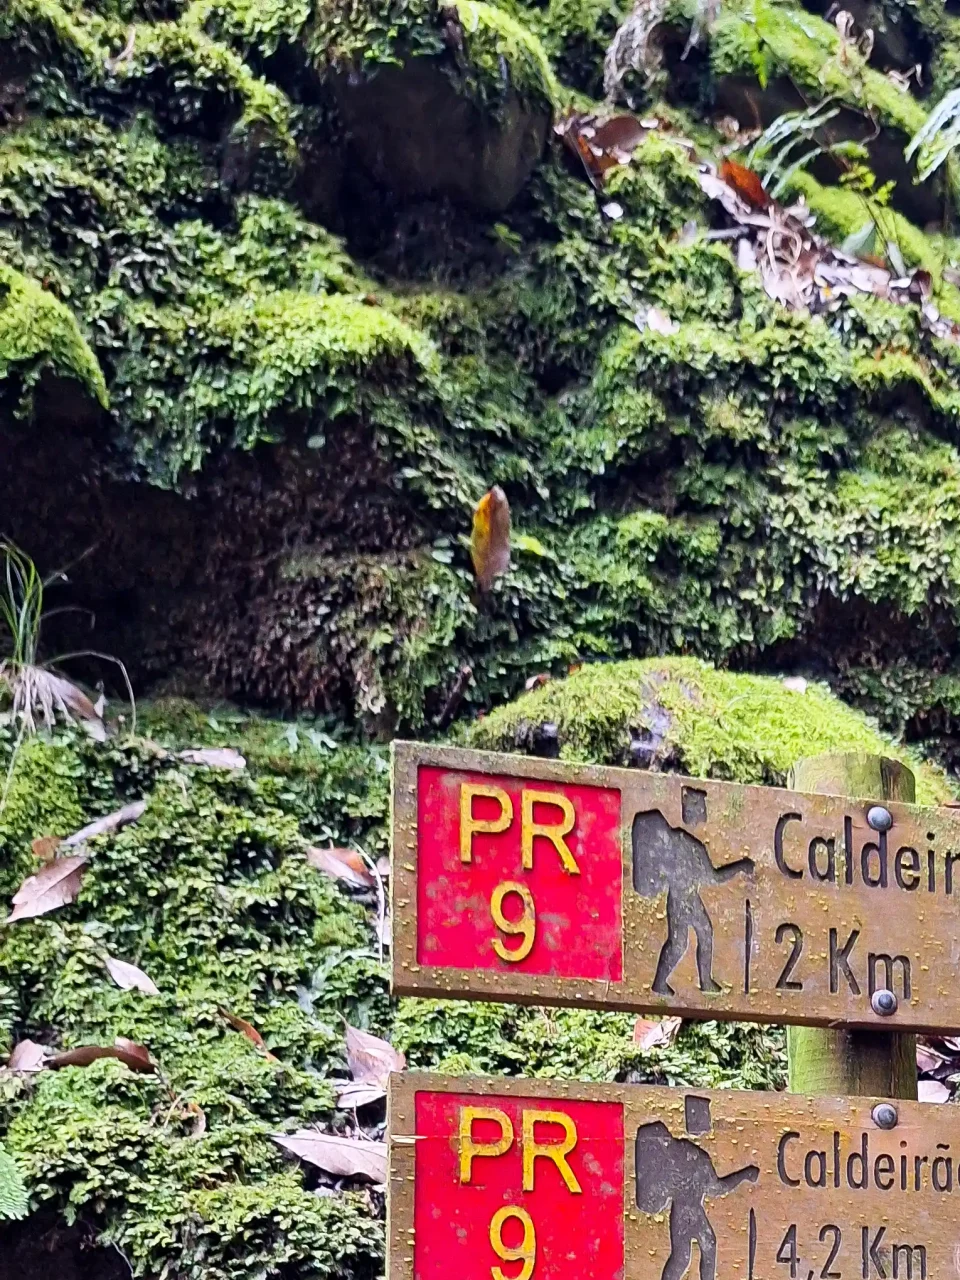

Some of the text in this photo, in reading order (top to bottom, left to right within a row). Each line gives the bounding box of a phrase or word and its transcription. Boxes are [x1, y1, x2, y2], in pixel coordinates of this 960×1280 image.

[460, 783, 581, 875] PR
[490, 881, 536, 962] 9
[774, 922, 912, 1001] 2 Km
[460, 1106, 582, 1193] PR
[861, 1226, 928, 1280] Km
